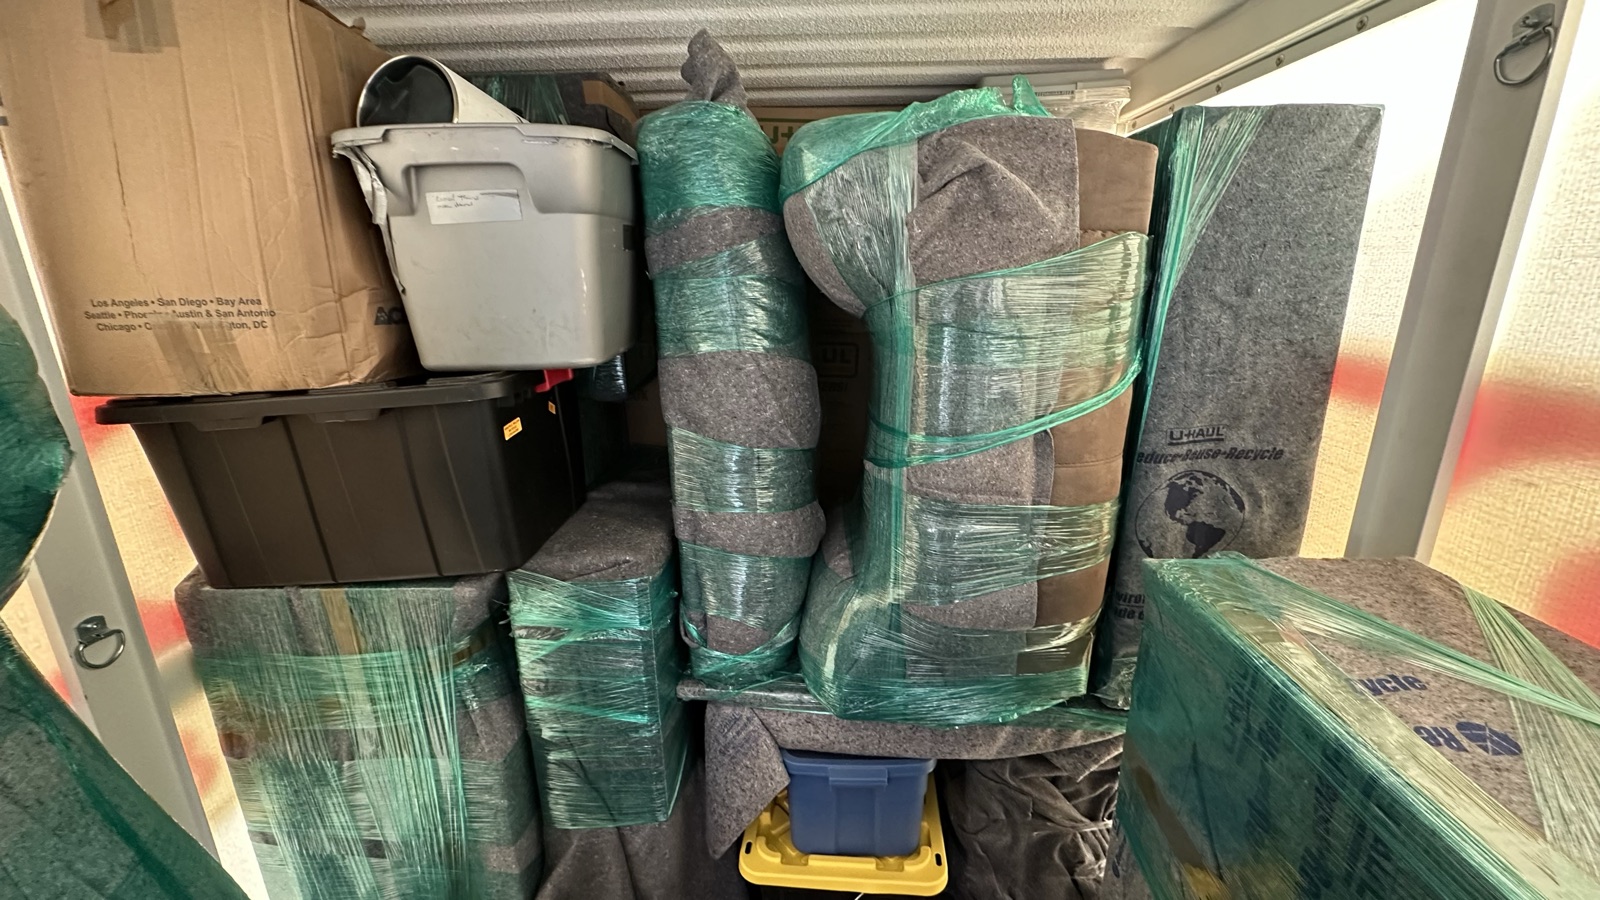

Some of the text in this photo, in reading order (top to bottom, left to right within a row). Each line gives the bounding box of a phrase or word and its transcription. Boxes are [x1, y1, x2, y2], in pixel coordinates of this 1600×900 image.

[90, 297, 262, 309] Los Angeles San Diego Bay Area
[84, 310, 117, 320] Seattle
[205, 309, 213, 318] &
[215, 309, 235, 318] San
[237, 308, 277, 318] Antonio
[96, 322, 137, 333] Chicago
[252, 320, 268, 329] DC
